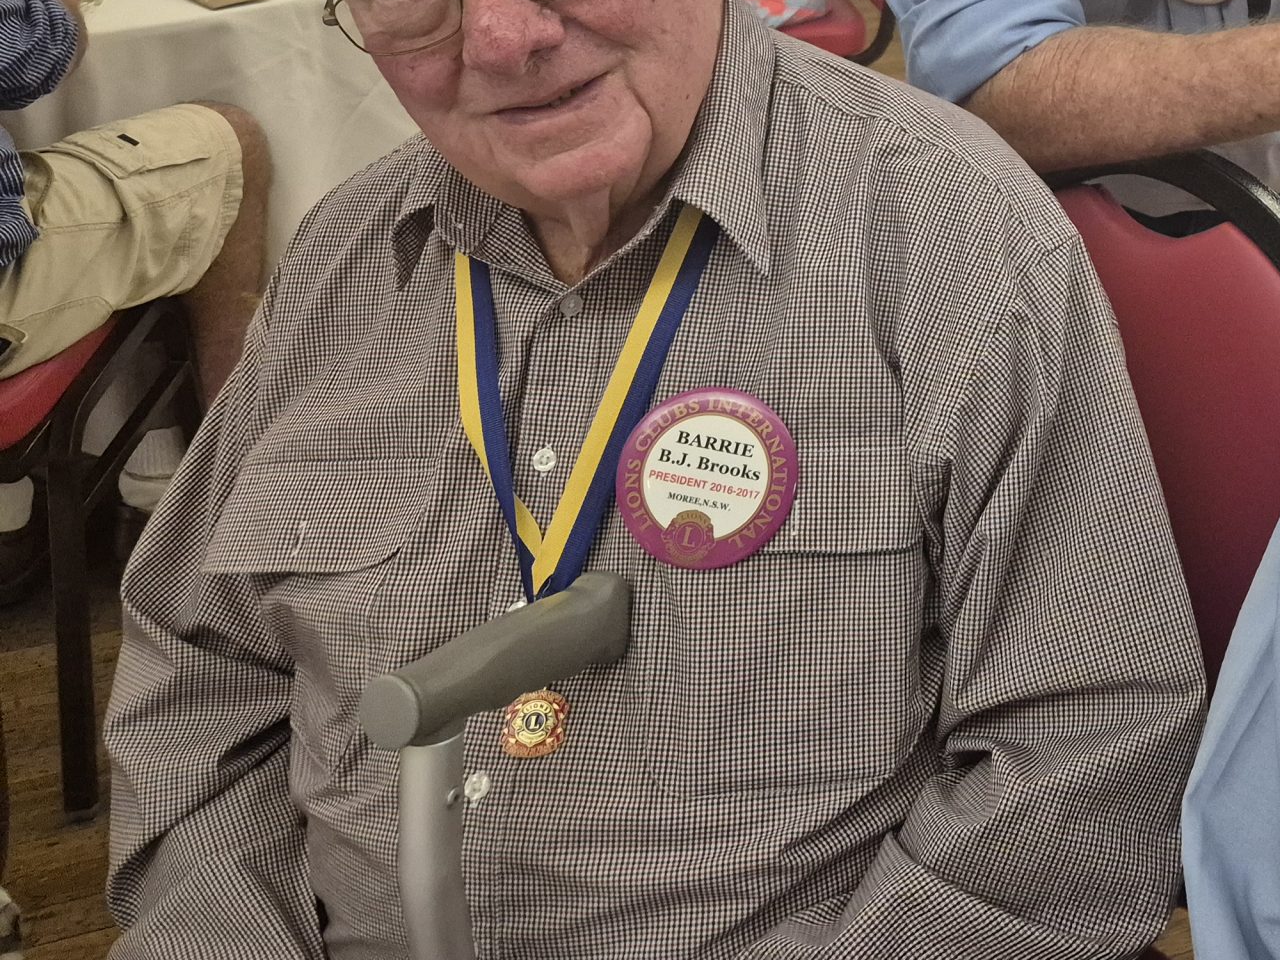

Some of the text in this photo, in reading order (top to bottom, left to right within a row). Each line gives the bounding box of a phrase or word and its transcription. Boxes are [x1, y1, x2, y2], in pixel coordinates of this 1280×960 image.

[676, 430, 755, 458] BARRIE
[625, 398, 788, 549] LIONS CLUBS INTERNATIONAL
[658, 448, 761, 481] B.J. Brooks
[649, 469, 761, 500] PRESIDENT 2016-2017
[529, 715, 540, 730] L
